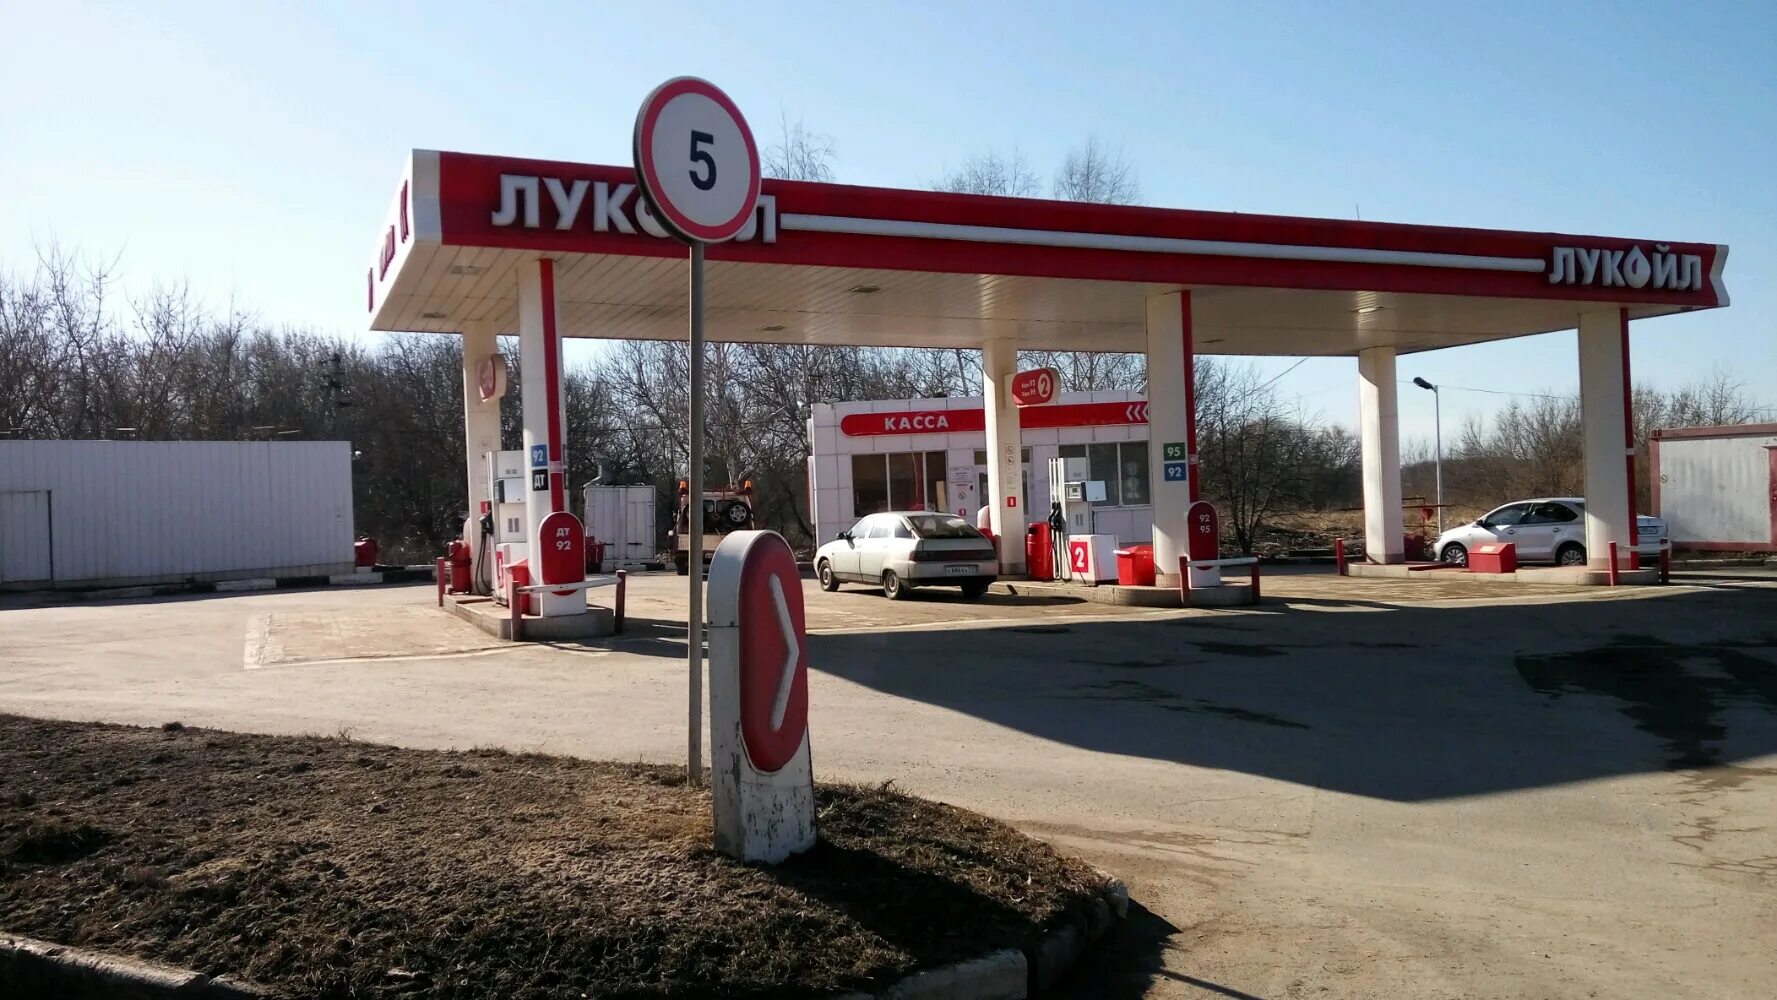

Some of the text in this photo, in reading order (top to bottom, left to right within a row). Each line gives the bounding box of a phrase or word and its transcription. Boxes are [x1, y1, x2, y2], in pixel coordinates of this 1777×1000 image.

[689, 130, 717, 191] 5
[1549, 244, 1702, 291] ЛУКОЙЛ
[1041, 377, 1048, 395] 2
[884, 415, 949, 430] КАССА
[533, 449, 544, 462] 92
[1167, 446, 1181, 457] 95
[1168, 466, 1182, 477] 92
[534, 473, 545, 488] ДТ
[1199, 514, 1210, 523] 92
[555, 527, 570, 537] ДТ
[1200, 525, 1211, 534] 95
[556, 540, 572, 550] 92
[1074, 546, 1085, 568] 2
